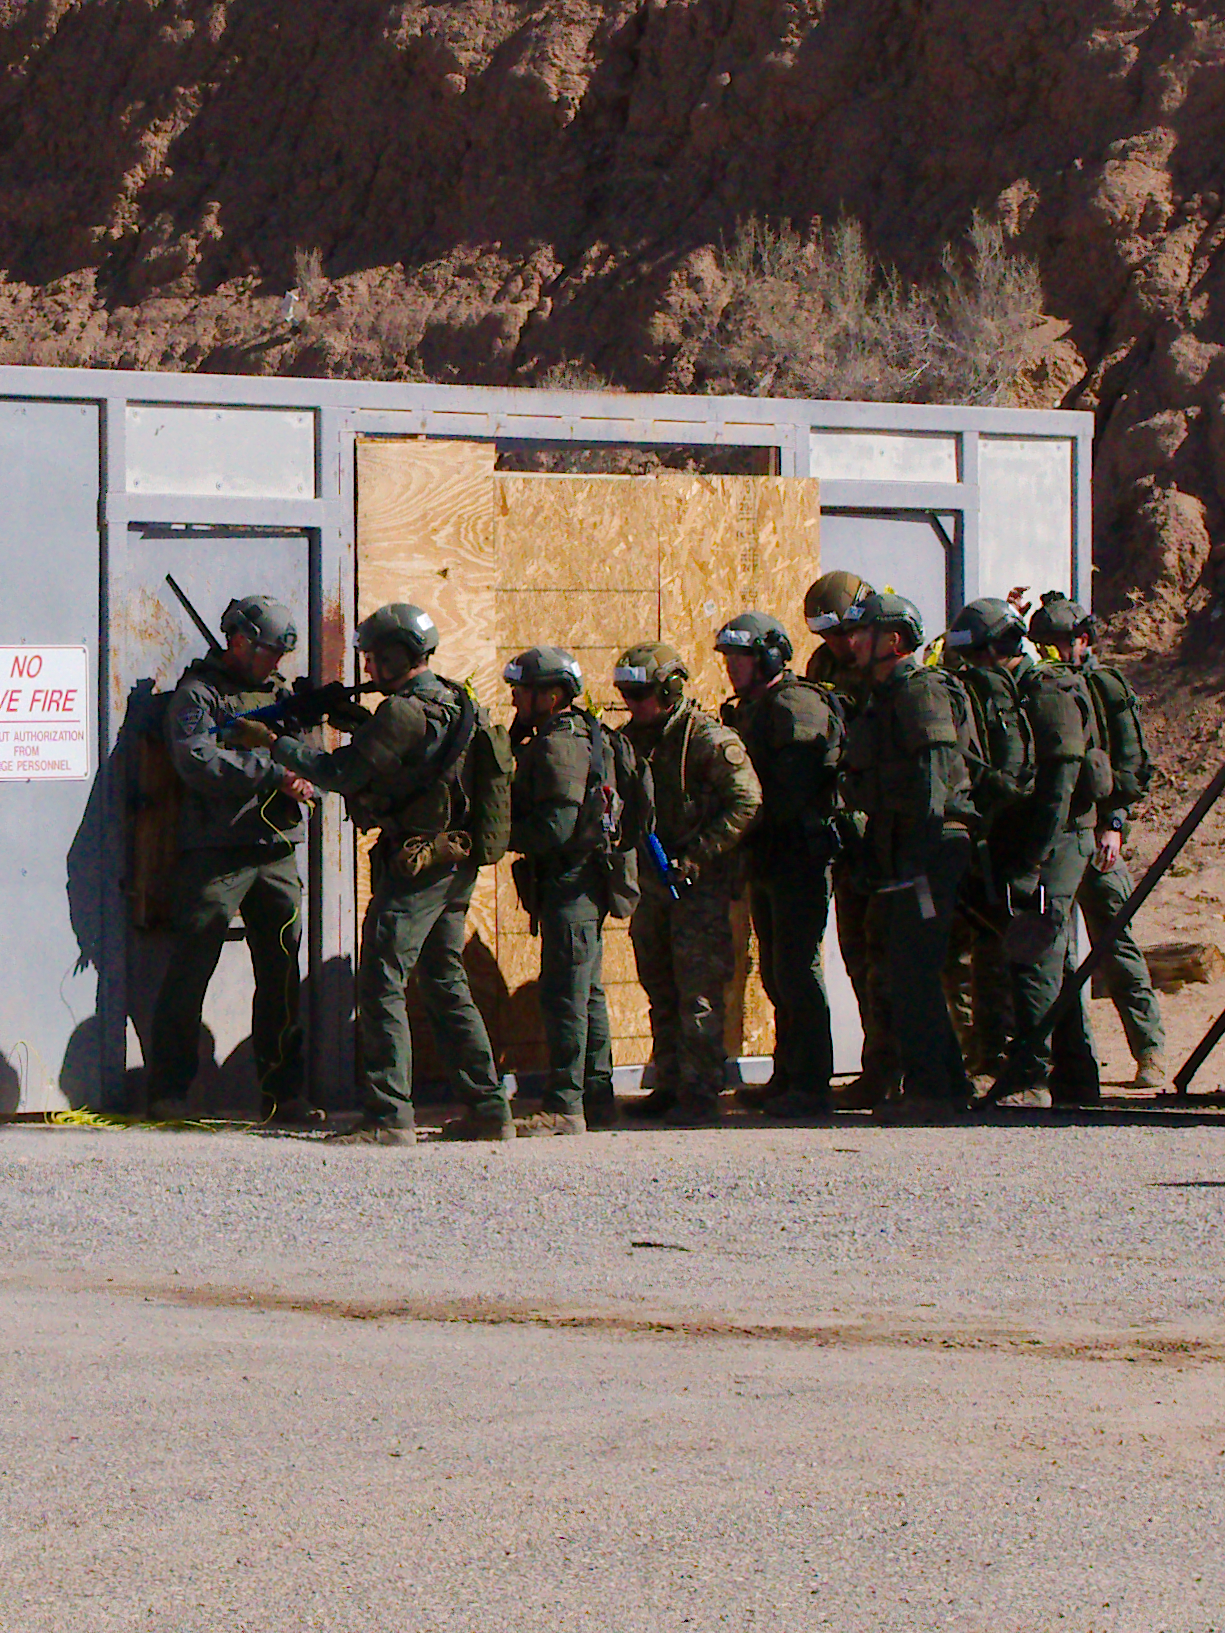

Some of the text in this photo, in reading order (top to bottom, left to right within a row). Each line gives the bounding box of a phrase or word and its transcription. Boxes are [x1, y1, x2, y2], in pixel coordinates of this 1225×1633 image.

[10, 655, 43, 678] NO
[29, 689, 78, 712] FIRE
[14, 730, 84, 742] AUTHORIZATION
[13, 746, 39, 756] FROM
[16, 760, 71, 771] PERSONNEL
